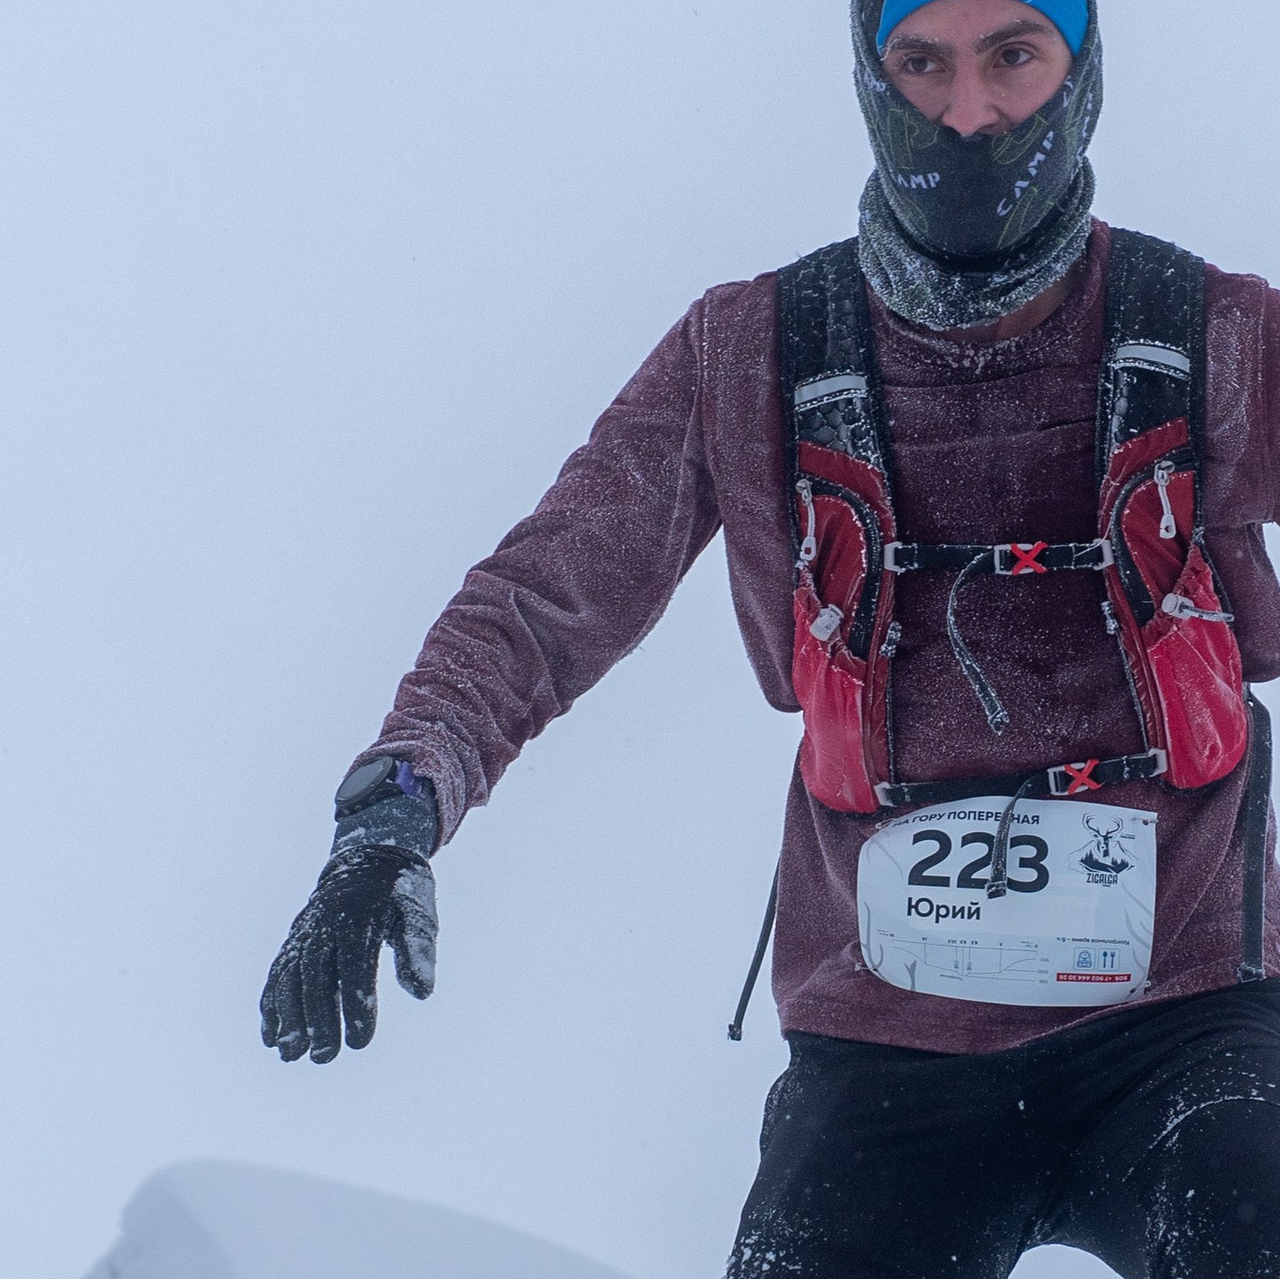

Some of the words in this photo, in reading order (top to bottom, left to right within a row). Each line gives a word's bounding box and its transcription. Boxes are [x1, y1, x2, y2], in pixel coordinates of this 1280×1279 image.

[898, 171, 941, 190] AMP
[996, 130, 1054, 217] CAMP
[911, 812, 947, 825] ГОРУ
[947, 810, 1040, 826] ПОПЕРЕНАЯ
[907, 829, 1050, 893] 223
[1086, 872, 1118, 885] ZIGALGA
[906, 897, 982, 924] Юрий
